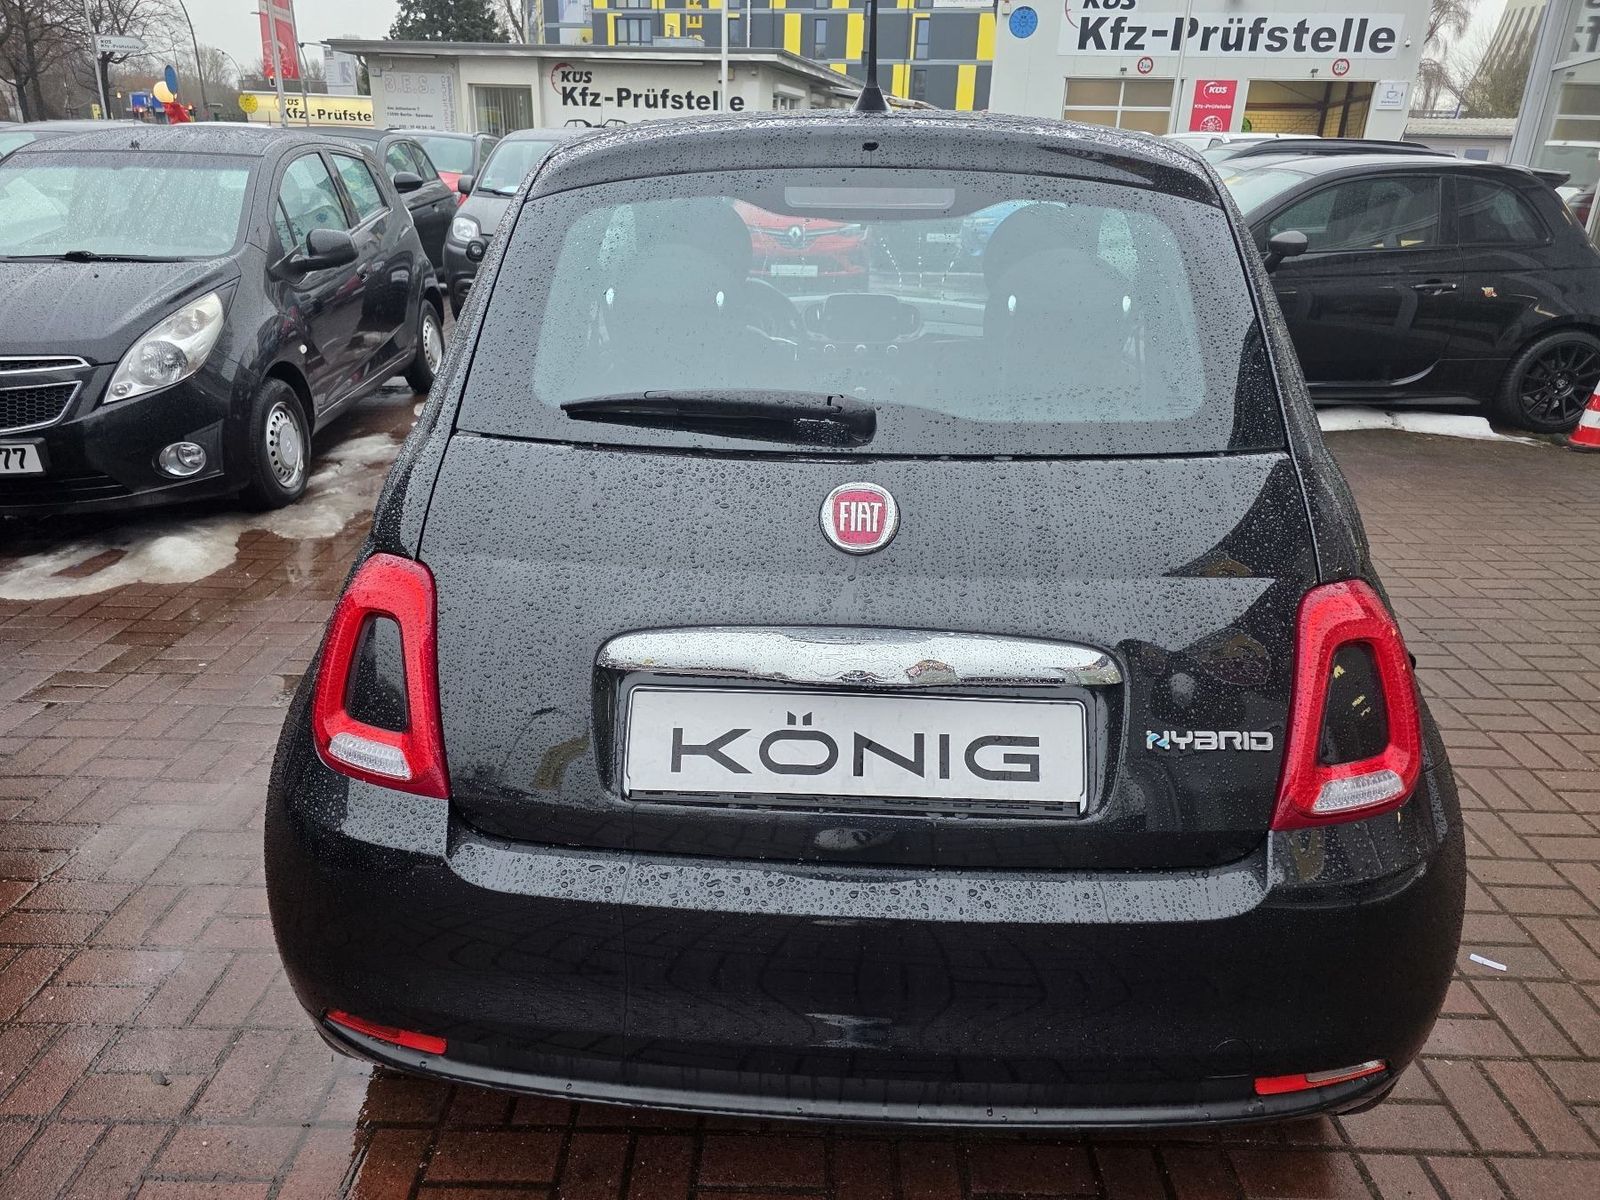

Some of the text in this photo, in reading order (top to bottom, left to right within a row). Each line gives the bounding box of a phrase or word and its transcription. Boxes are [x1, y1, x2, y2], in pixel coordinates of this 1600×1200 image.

[1077, 16, 1396, 54] Kfz-Prüfstelle
[561, 70, 592, 83] KÜS
[562, 86, 745, 112] Kfz-Prüfstele
[839, 501, 883, 533] FIAT
[670, 710, 1040, 782] KÖNIG
[1146, 730, 1274, 751] HYBRID
